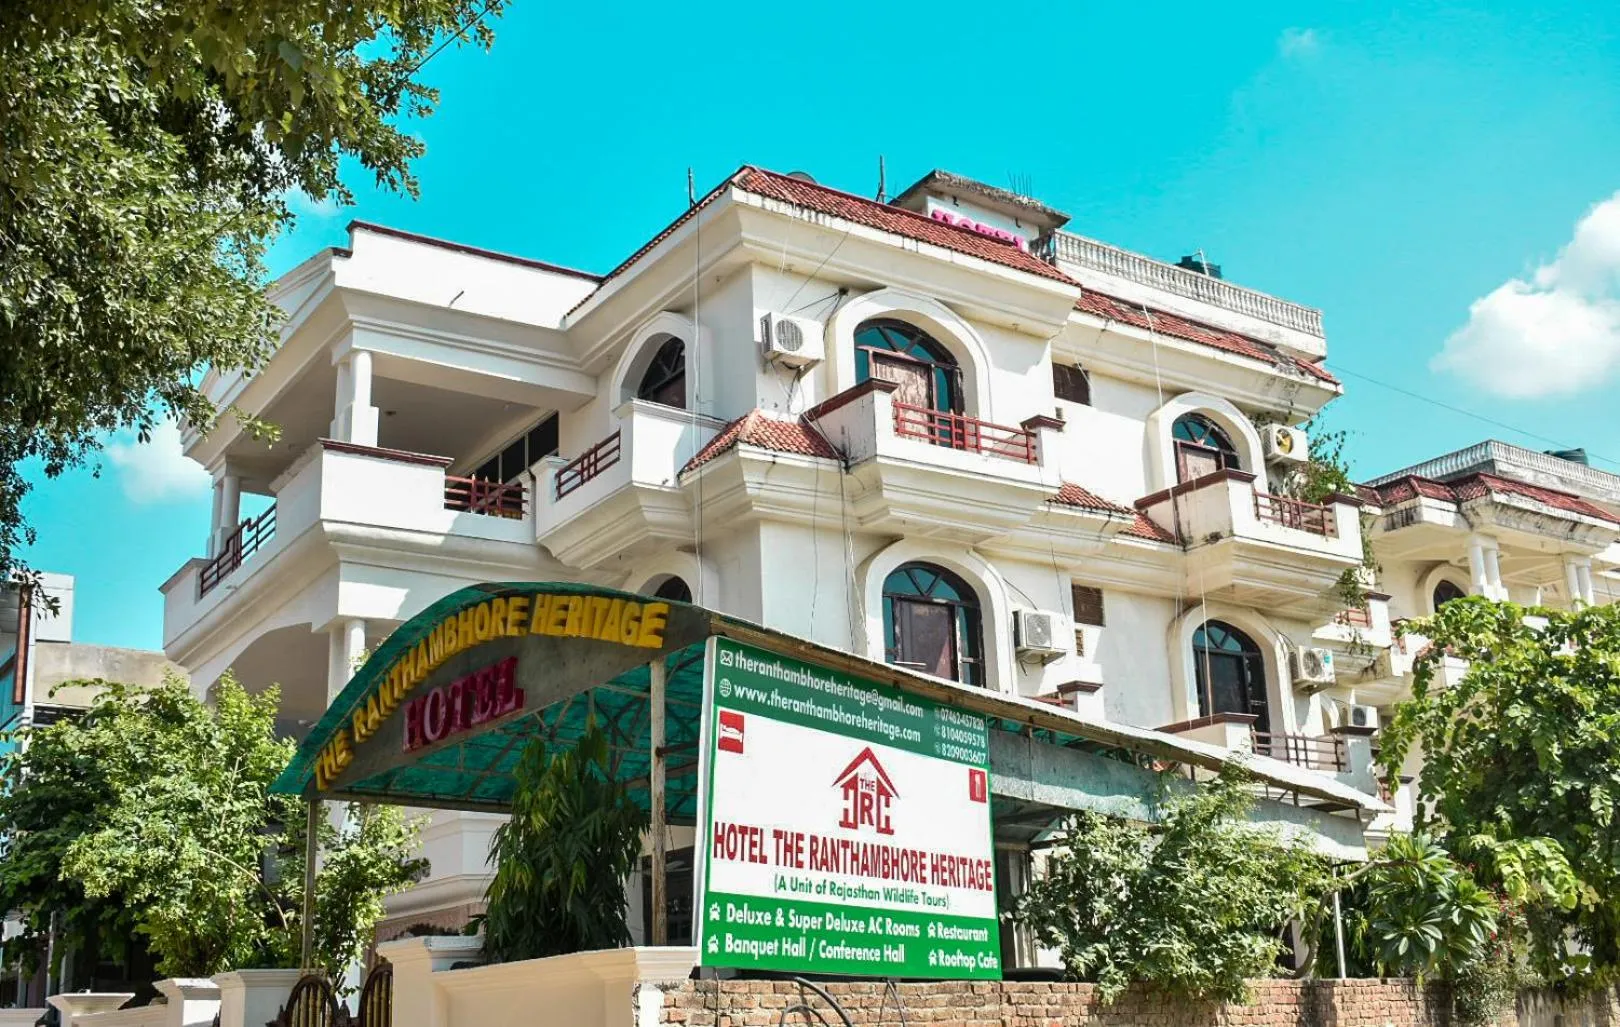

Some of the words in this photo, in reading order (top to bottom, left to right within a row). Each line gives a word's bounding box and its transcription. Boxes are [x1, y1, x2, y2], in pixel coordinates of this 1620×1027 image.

[315, 729, 351, 791] THE
[352, 597, 532, 743] RANTHAMBHORE
[530, 593, 672, 649] HERITAGE
[735, 650, 924, 718] theranthambhoreheritage@gmail.com
[402, 656, 525, 752] HOTEL
[733, 683, 921, 742] www.theranthambhoreheritage.com
[860, 778, 875, 792] THE
[713, 821, 768, 865] HOTEL
[773, 829, 805, 869] THE
[809, 835, 928, 885] RANTHAMBHORE
[930, 852, 993, 892] HERITAGE
[774, 873, 787, 893] (A
[790, 876, 813, 893] Unit
[815, 879, 827, 895] of
[829, 881, 880, 901] Rajasthan
[882, 886, 919, 905] Wildlife
[921, 891, 950, 910] Tours)
[726, 902, 772, 926] Deluxe
[775, 907, 785, 928] &
[788, 908, 823, 934] Super
[825, 911, 865, 933] Deluxe
[867, 916, 883, 935] AC
[885, 917, 920, 938] Rooms
[937, 921, 989, 942] Restaurant
[724, 932, 779, 960] Banquet
[781, 936, 806, 957] Hall
[819, 939, 881, 962] Conference
[883, 943, 905, 963] Hall
[938, 949, 976, 973] Rooftop
[977, 951, 999, 969] Cafe
